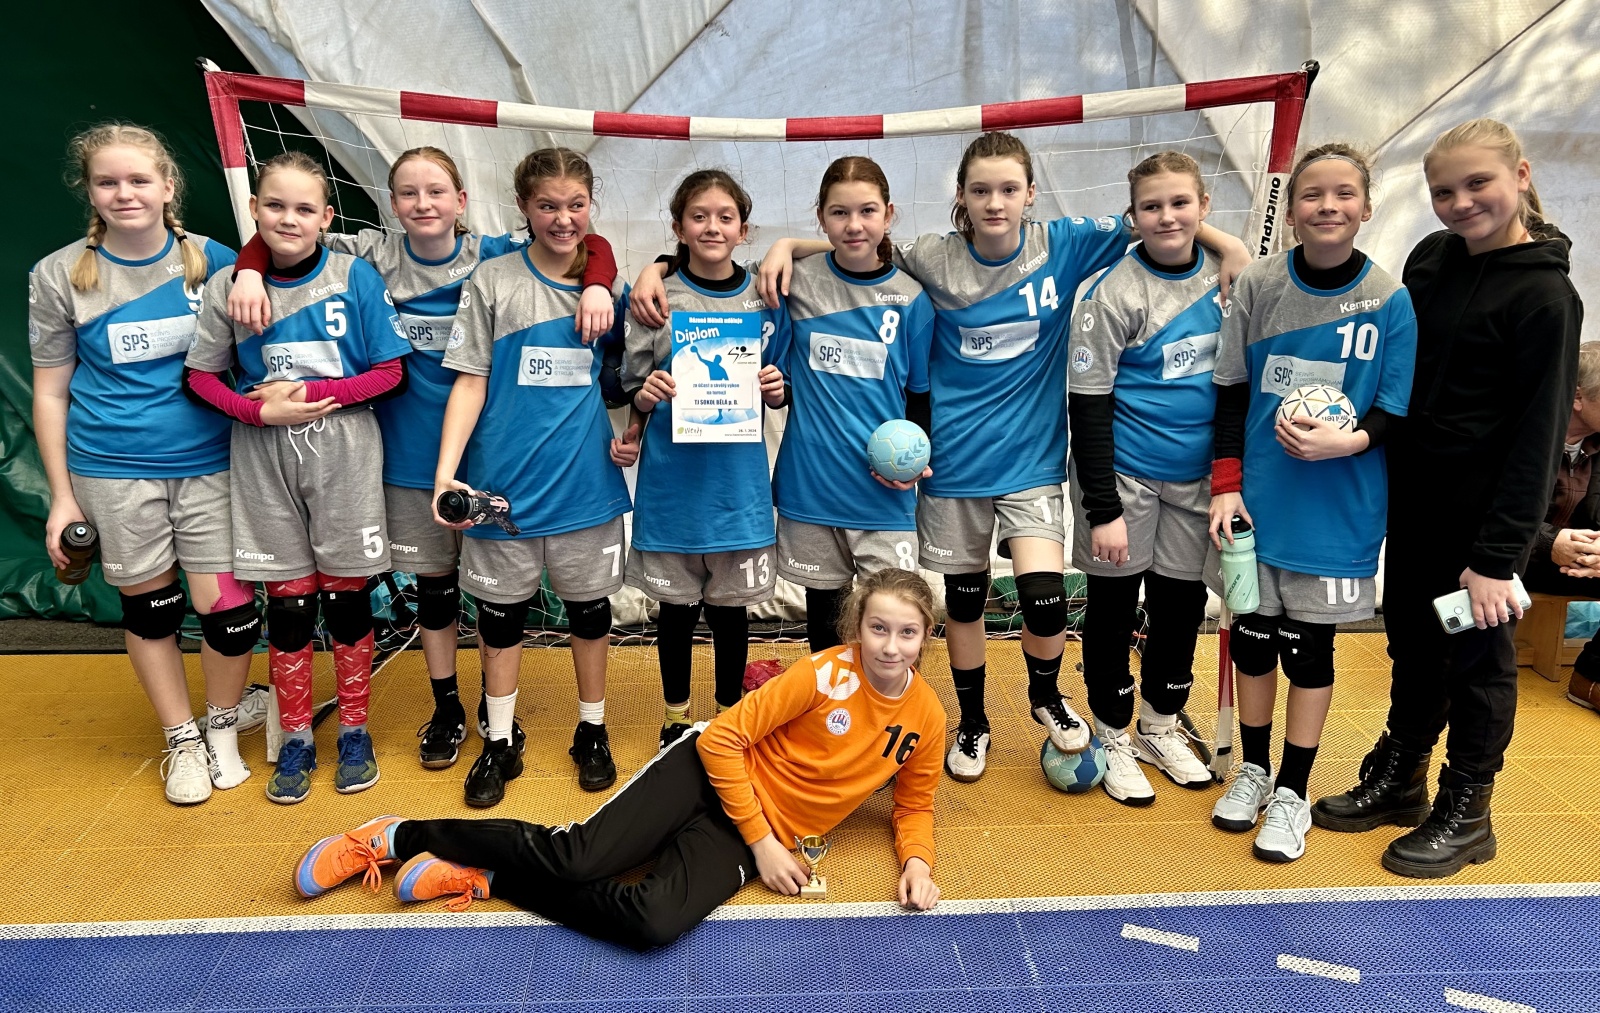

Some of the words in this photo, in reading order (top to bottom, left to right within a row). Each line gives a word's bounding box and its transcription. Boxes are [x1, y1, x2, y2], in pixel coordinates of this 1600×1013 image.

[1258, 177, 1281, 259] QUICKPLA
[166, 264, 186, 275] Kem
[1018, 250, 1049, 274] Kempa
[309, 281, 345, 298] Kempa
[874, 292, 909, 303] Kempa
[1018, 275, 1059, 317] 14
[1339, 298, 1380, 313] Kempa
[324, 301, 347, 338] 5
[879, 309, 900, 345] 8
[122, 333, 150, 352] SPS
[409, 326, 433, 341] SPS
[675, 326, 720, 344] Diplom
[1336, 321, 1379, 361] 10
[971, 336, 993, 351] SPS
[270, 354, 293, 372] SPS
[819, 345, 842, 364] SPS
[1174, 349, 1197, 368] SPS
[529, 358, 552, 376] SPS
[1274, 366, 1293, 386] SPS
[361, 524, 384, 559] 5
[923, 540, 953, 557] Kempa
[236, 548, 274, 562] Kempa
[602, 543, 622, 577] 7
[895, 541, 915, 572] 8
[104, 562, 123, 572] mpa
[739, 552, 770, 588] 13
[788, 557, 820, 572] Kempa
[467, 568, 498, 586] Kempa
[1319, 576, 1360, 605] 10
[150, 592, 183, 608] Kempa
[1034, 595, 1061, 606] ALLSIX
[482, 603, 505, 618] Kempa
[226, 617, 259, 634] Kempa
[1238, 624, 1271, 640] Kempa
[881, 723, 921, 766] 16
